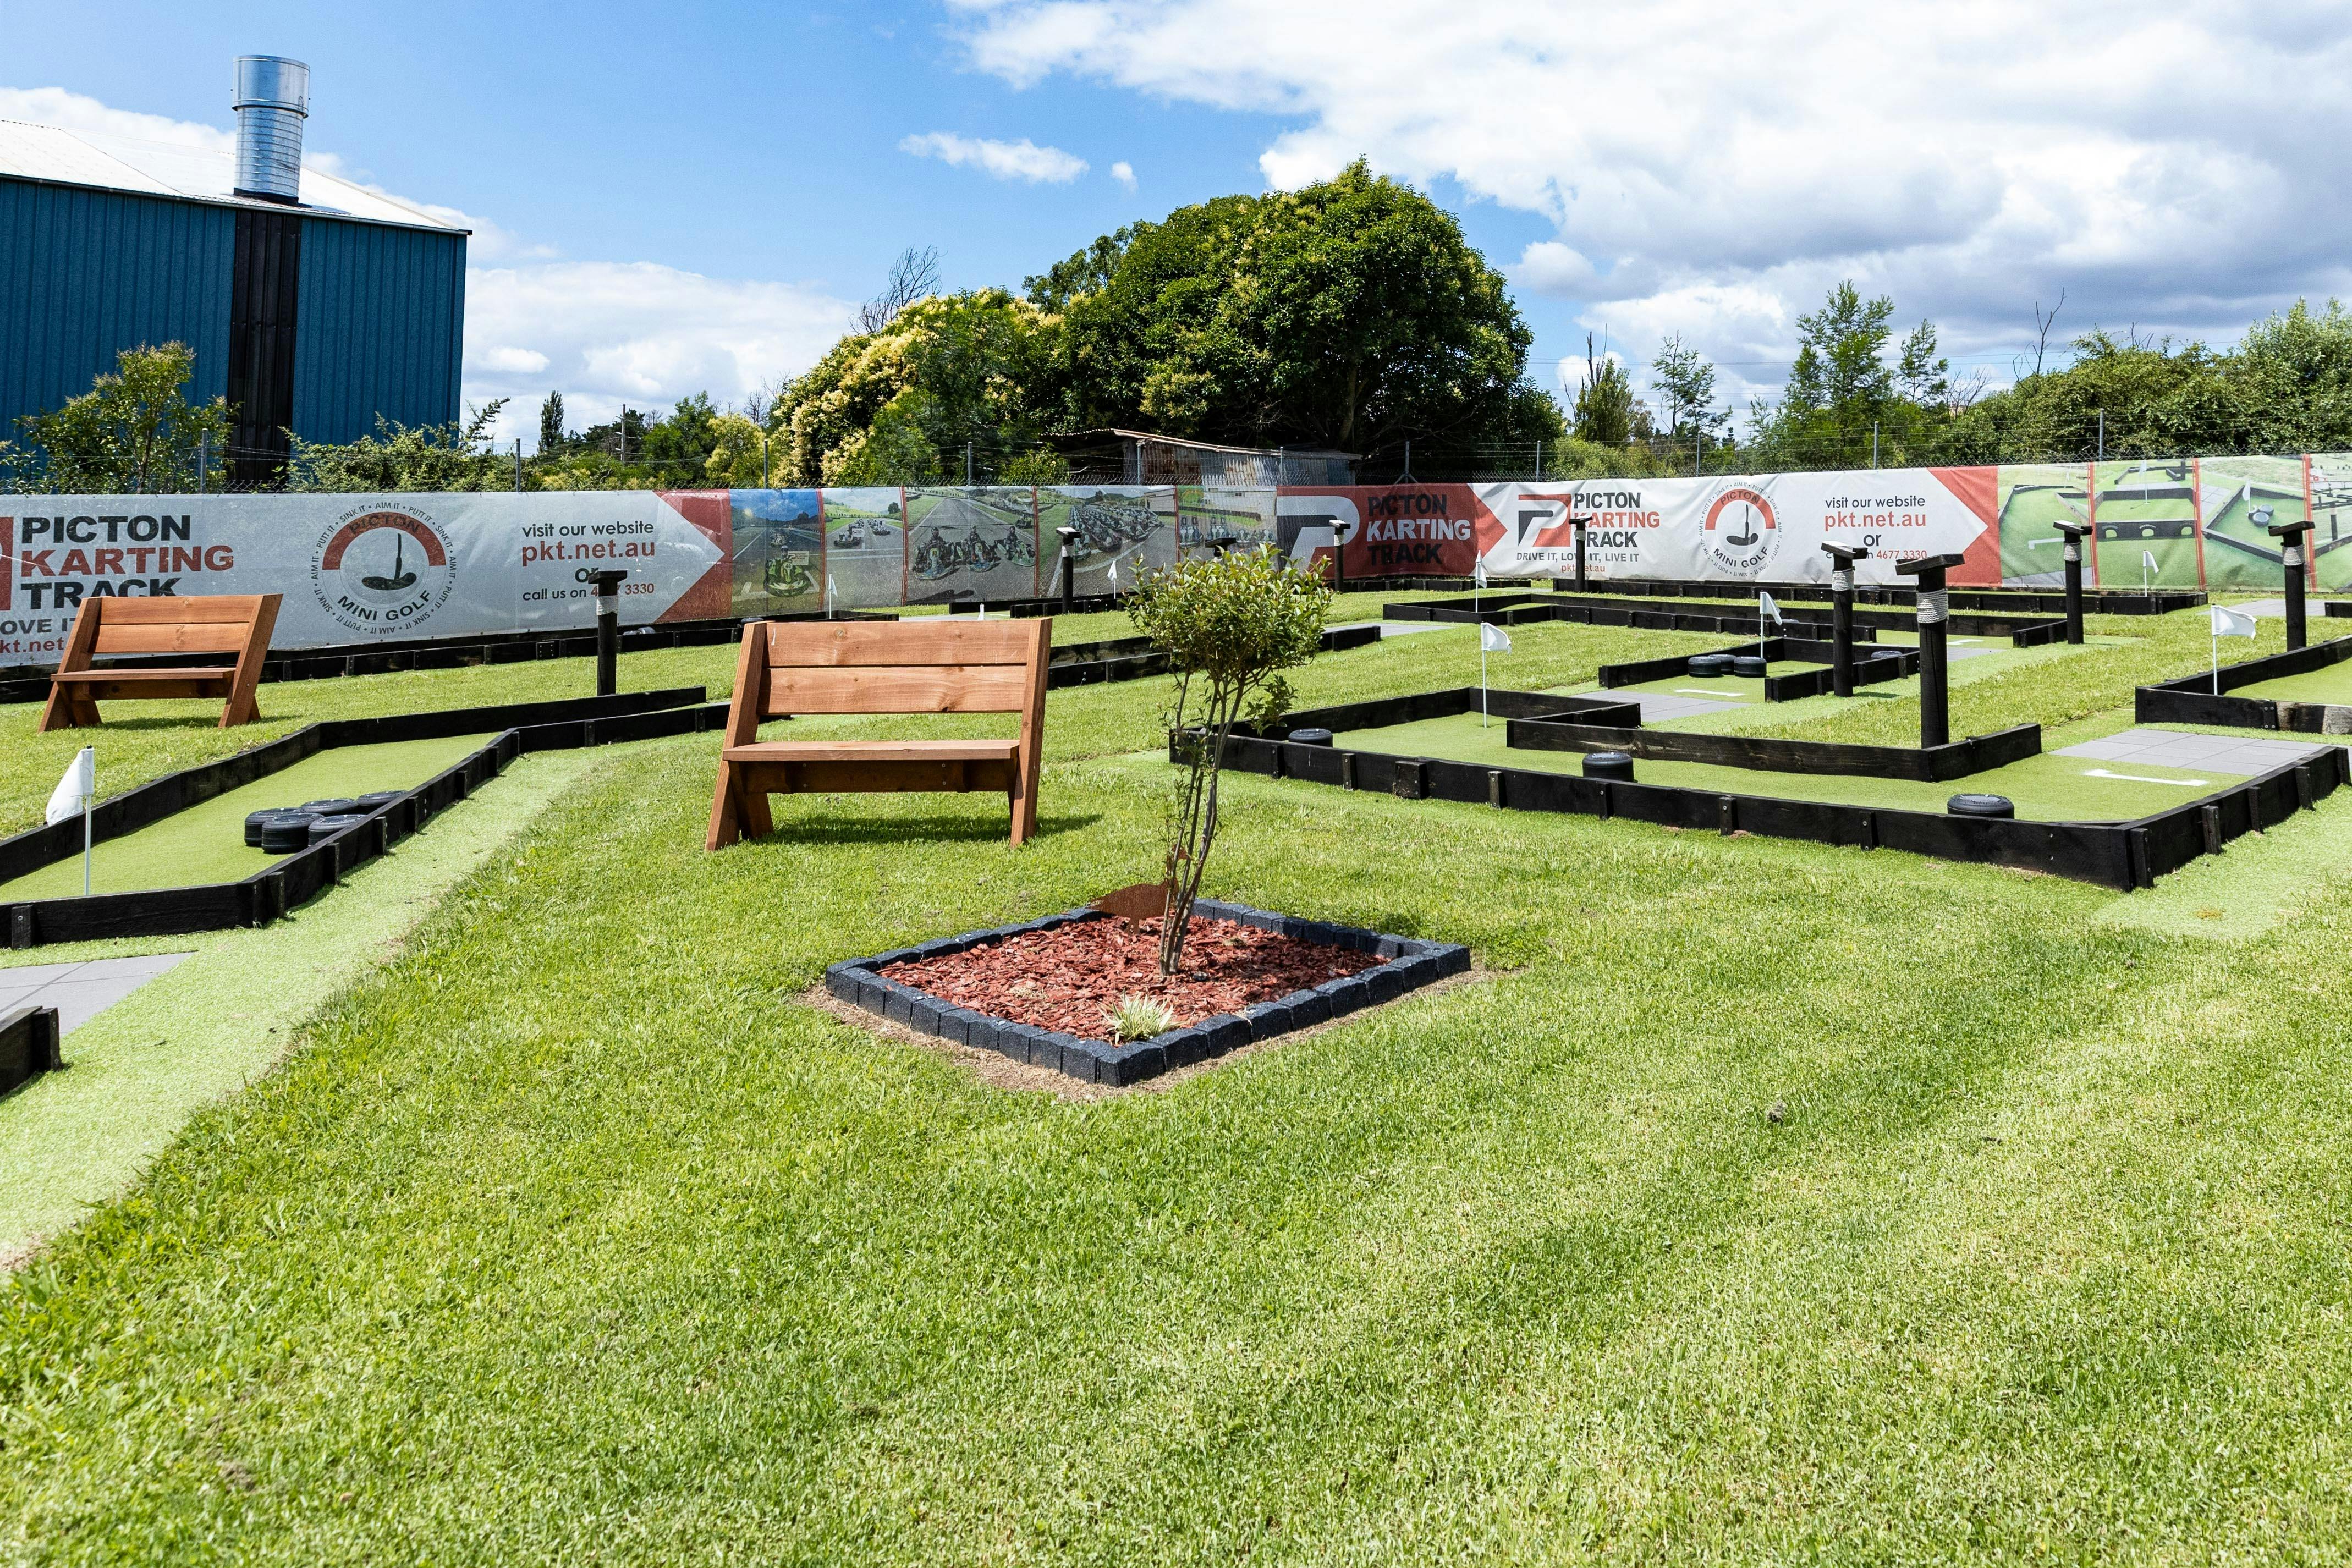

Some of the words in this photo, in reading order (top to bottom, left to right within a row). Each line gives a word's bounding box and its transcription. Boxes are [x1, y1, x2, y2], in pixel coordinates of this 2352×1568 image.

[1367, 494, 1447, 517] PICTON
[1574, 492, 1641, 509] PICTON
[1719, 491, 1760, 505] PICTON
[1825, 497, 1848, 508] visit
[1852, 499, 1872, 508] our
[1875, 495, 1925, 508] website
[339, 509, 359, 522] SINK
[409, 506, 426, 519] PUTT
[1825, 511, 1926, 531] pkt.net.au
[21, 515, 190, 543] PICTON
[348, 515, 420, 535] PICTON
[435, 525, 449, 541] SINK
[522, 523, 554, 537] visit
[559, 525, 586, 536] our
[591, 521, 654, 535] website
[1366, 518, 1471, 542] KARTING
[316, 531, 331, 548] PUTT
[445, 541, 453, 551] IT
[1574, 531, 1638, 548] RACK
[1863, 534, 1881, 547] or
[21, 544, 234, 577] KARTING
[523, 539, 655, 566] pkt.net.au
[1367, 543, 1443, 566] TRACK
[1516, 552, 1545, 560] DRIVE
[1547, 553, 1558, 563] IT,
[1590, 553, 1601, 563] IT,
[1605, 553, 1626, 562] LIVE
[1630, 553, 1640, 562] IT
[1713, 548, 1736, 567] MINI
[1741, 546, 1768, 568] GOLF
[1876, 550, 1899, 559] 4677
[1903, 550, 1927, 559] 3330
[1561, 563, 1605, 573] pktet.au
[20, 577, 182, 609] TRACK
[441, 586, 452, 603] PUTT
[523, 588, 548, 601] call
[552, 590, 566, 599] us
[570, 589, 587, 598] on
[624, 583, 655, 595] 3330
[317, 595, 333, 612] SINK
[337, 595, 378, 621] MINI
[385, 590, 431, 621] GOLF
[343, 619, 360, 631] PUTT
[414, 613, 430, 626] SINK
